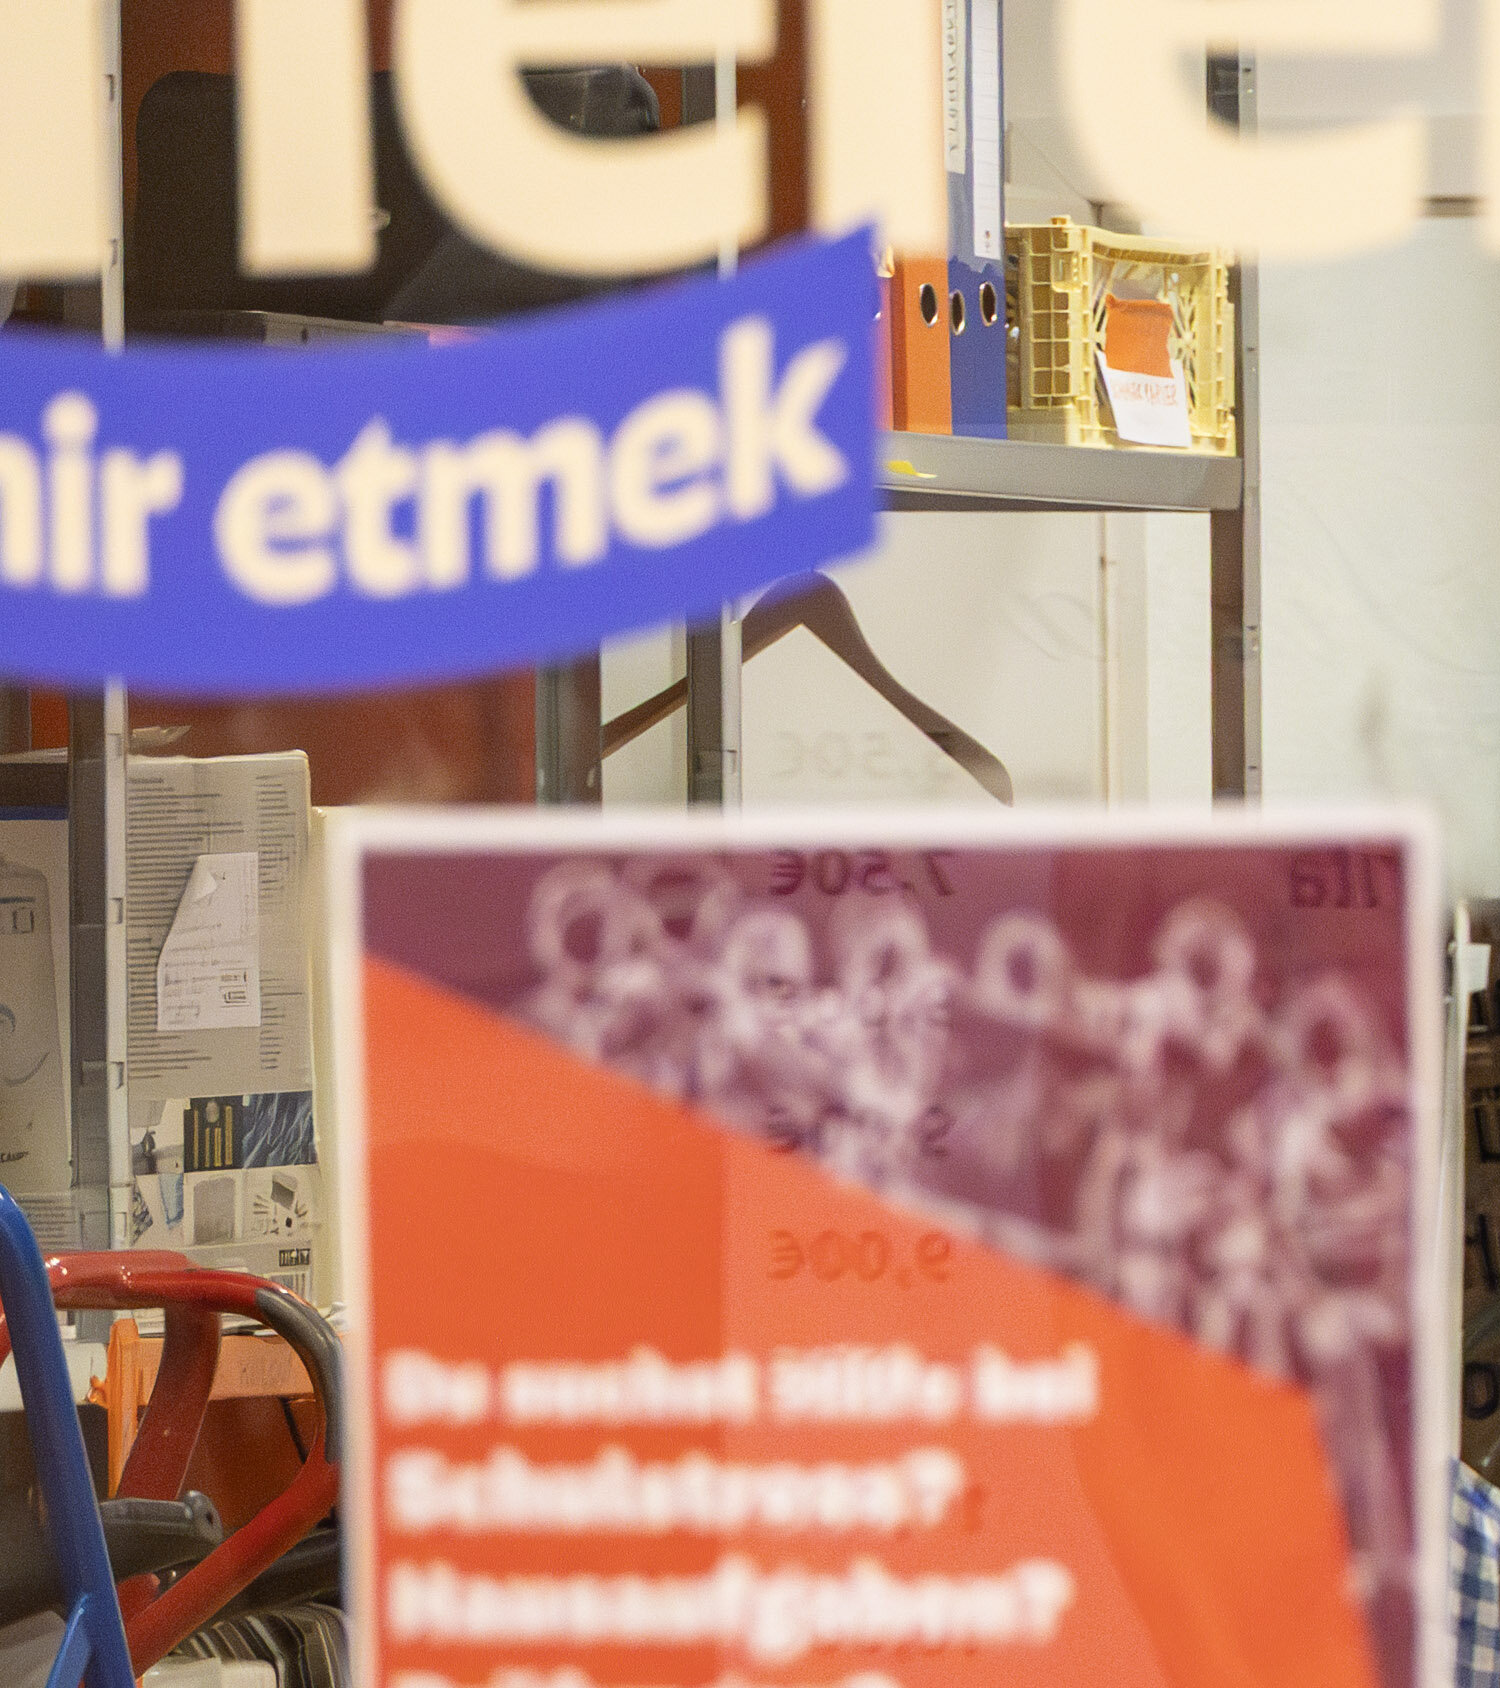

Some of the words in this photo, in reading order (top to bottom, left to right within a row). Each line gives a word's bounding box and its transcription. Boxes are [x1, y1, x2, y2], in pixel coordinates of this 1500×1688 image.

[215, 316, 849, 606] etmek
[386, 1447, 962, 1531] Schulstress?
[388, 1559, 1074, 1663] Hausaufgaben?
